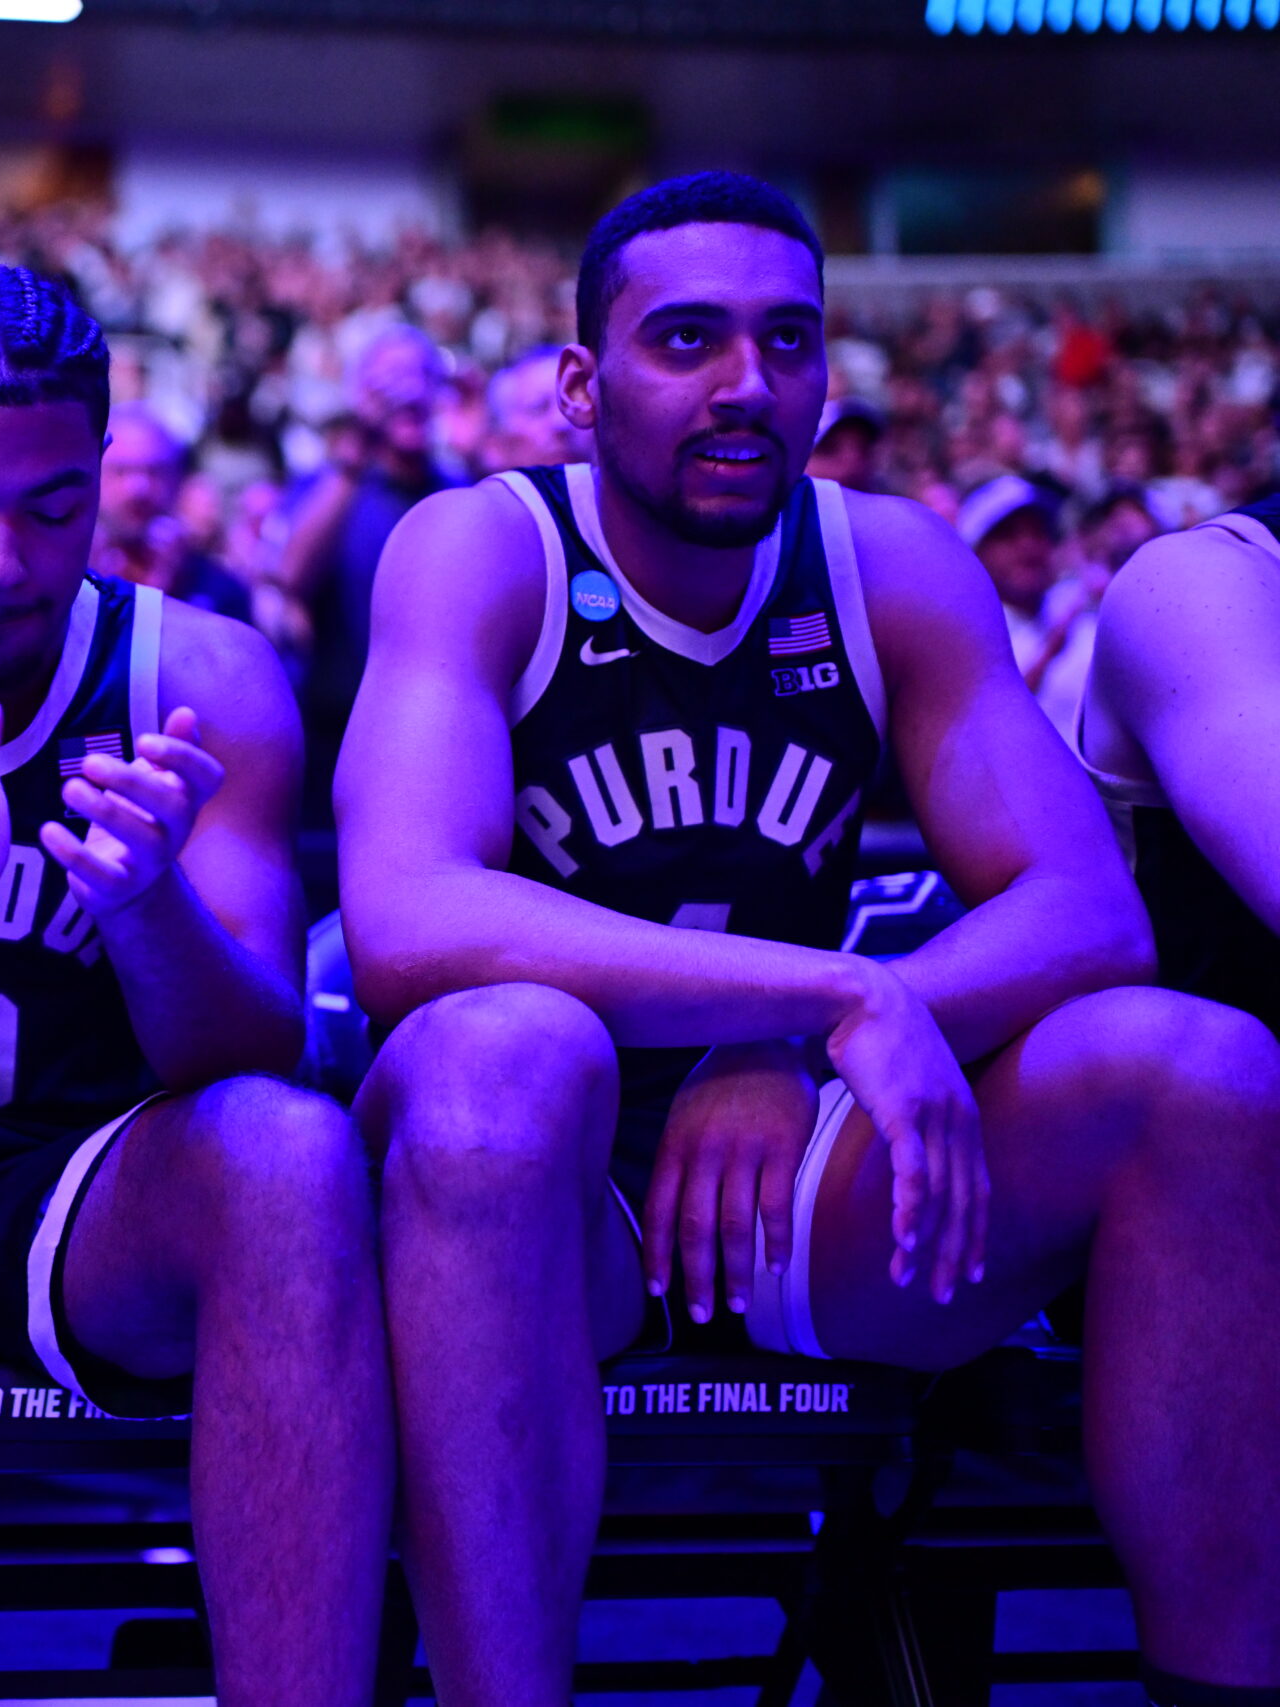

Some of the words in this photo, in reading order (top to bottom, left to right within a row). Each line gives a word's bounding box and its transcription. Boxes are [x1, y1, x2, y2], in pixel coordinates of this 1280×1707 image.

[576, 592, 616, 609] NCAA
[10, 1387, 63, 1419] THE
[603, 1385, 636, 1415] TO
[642, 1384, 692, 1414] THE
[698, 1382, 772, 1413] FINAL
[779, 1383, 850, 1413] FOUR
